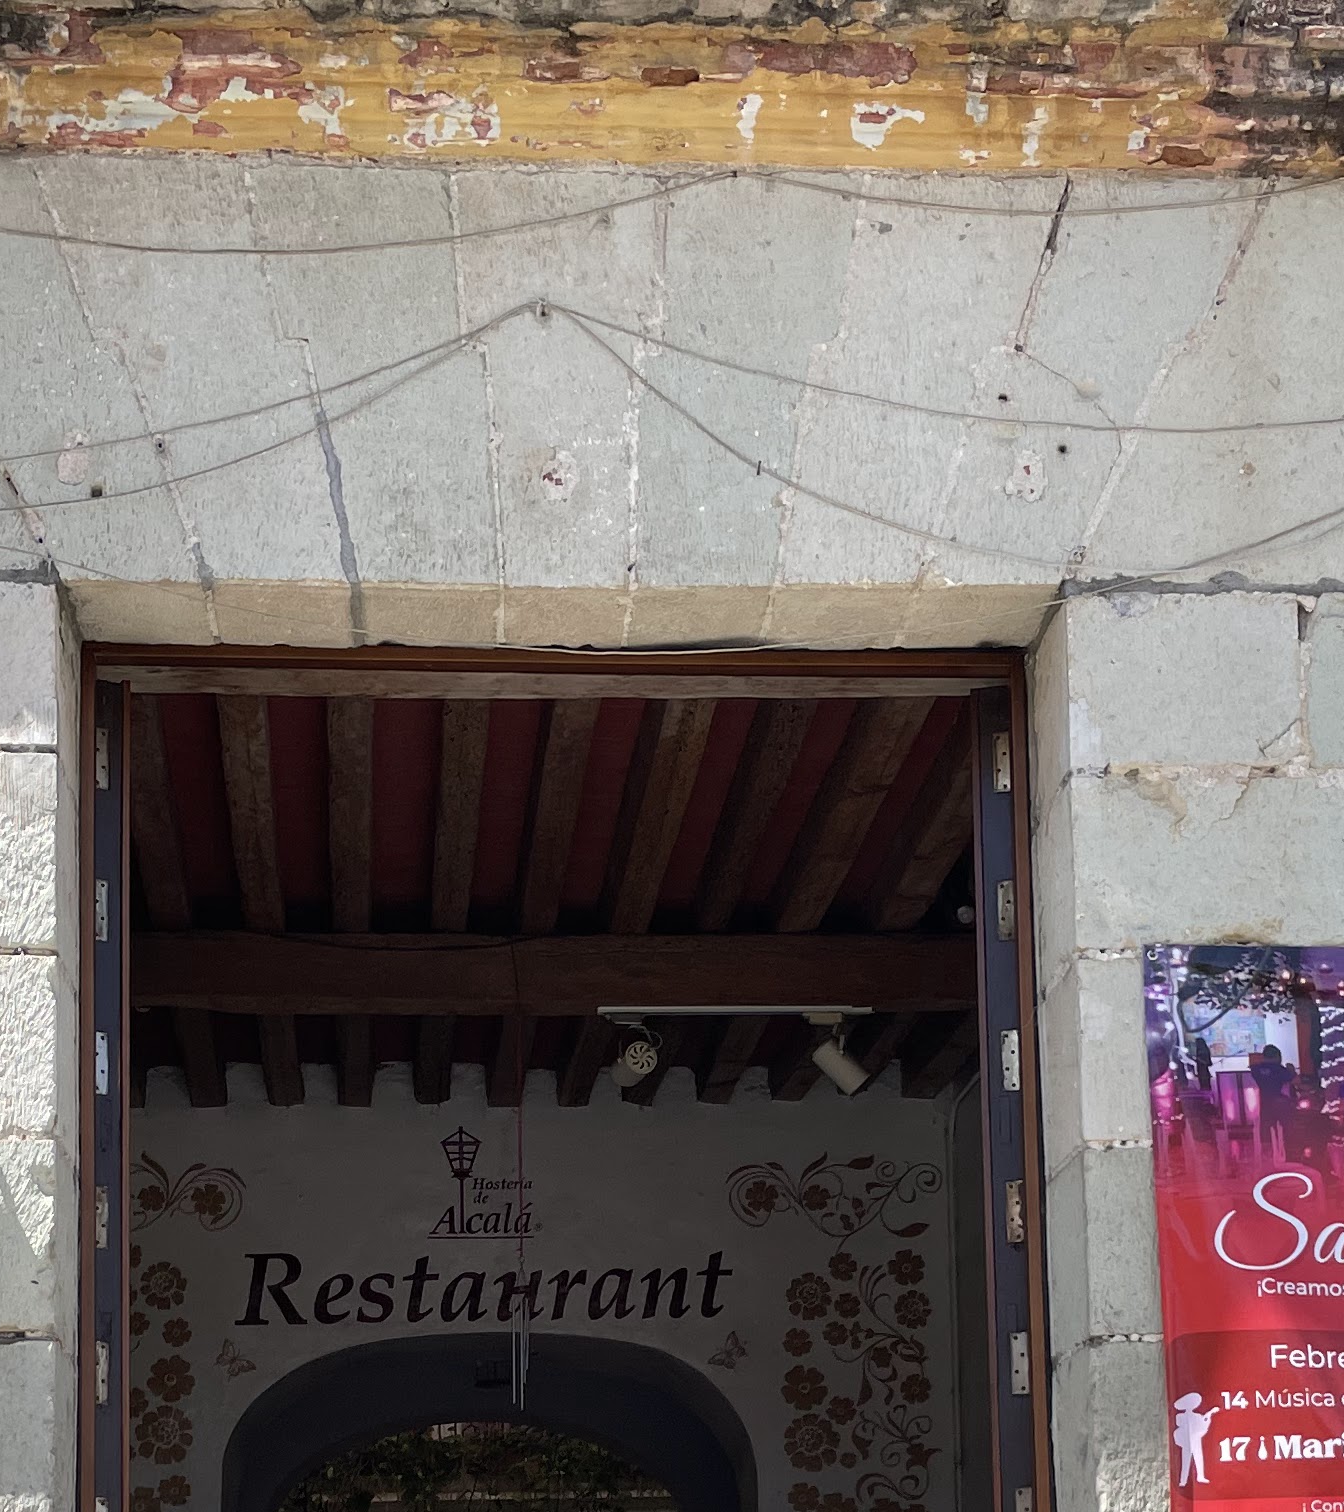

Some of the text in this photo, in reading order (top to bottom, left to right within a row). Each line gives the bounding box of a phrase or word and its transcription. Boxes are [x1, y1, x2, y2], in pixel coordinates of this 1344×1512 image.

[473, 1191, 489, 1203] de
[429, 1202, 533, 1234] Alcalá
[235, 1250, 733, 1327] Restaurant
[1221, 1391, 1248, 1410] 14
[1255, 1388, 1335, 1409] Música
[1219, 1436, 1251, 1462] 17
